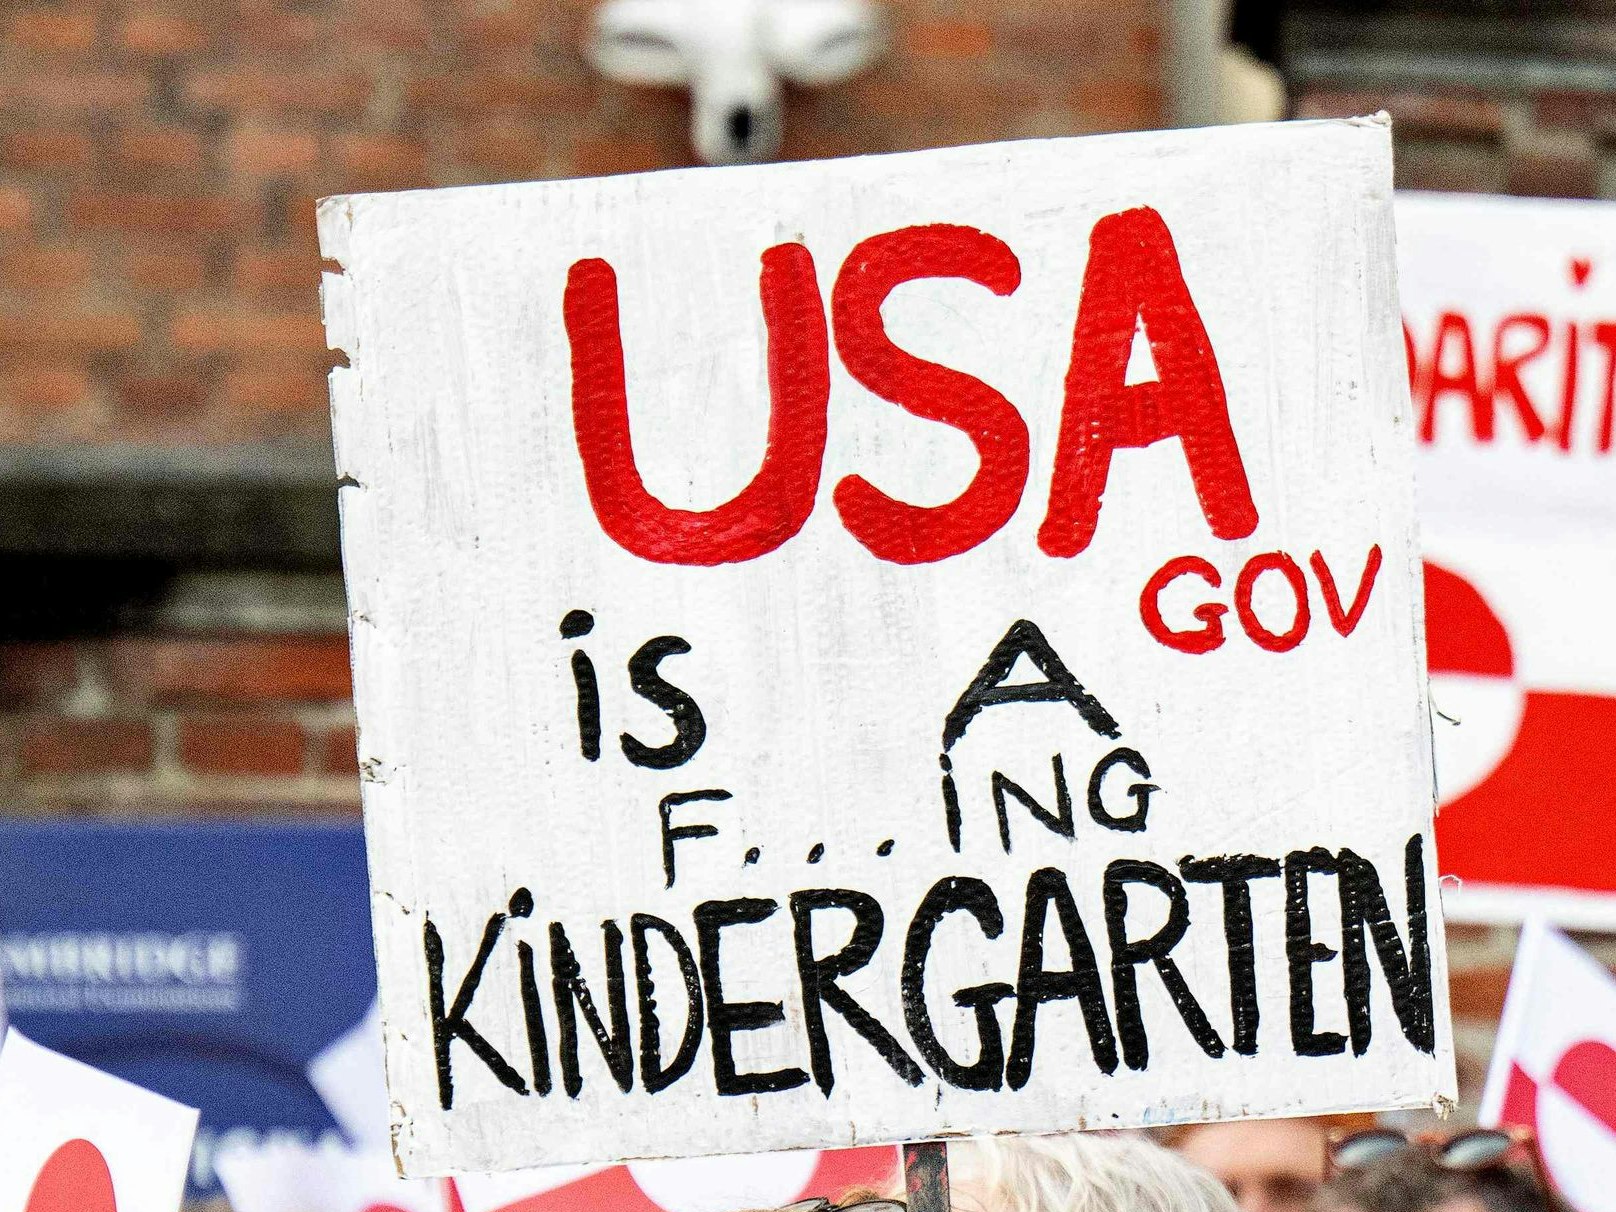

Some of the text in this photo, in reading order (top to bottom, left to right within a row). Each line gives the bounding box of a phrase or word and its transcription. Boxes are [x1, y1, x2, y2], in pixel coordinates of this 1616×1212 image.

[563, 206, 1260, 566] USA
[1139, 544, 1383, 654] GOV
[942, 619, 1122, 752] A
